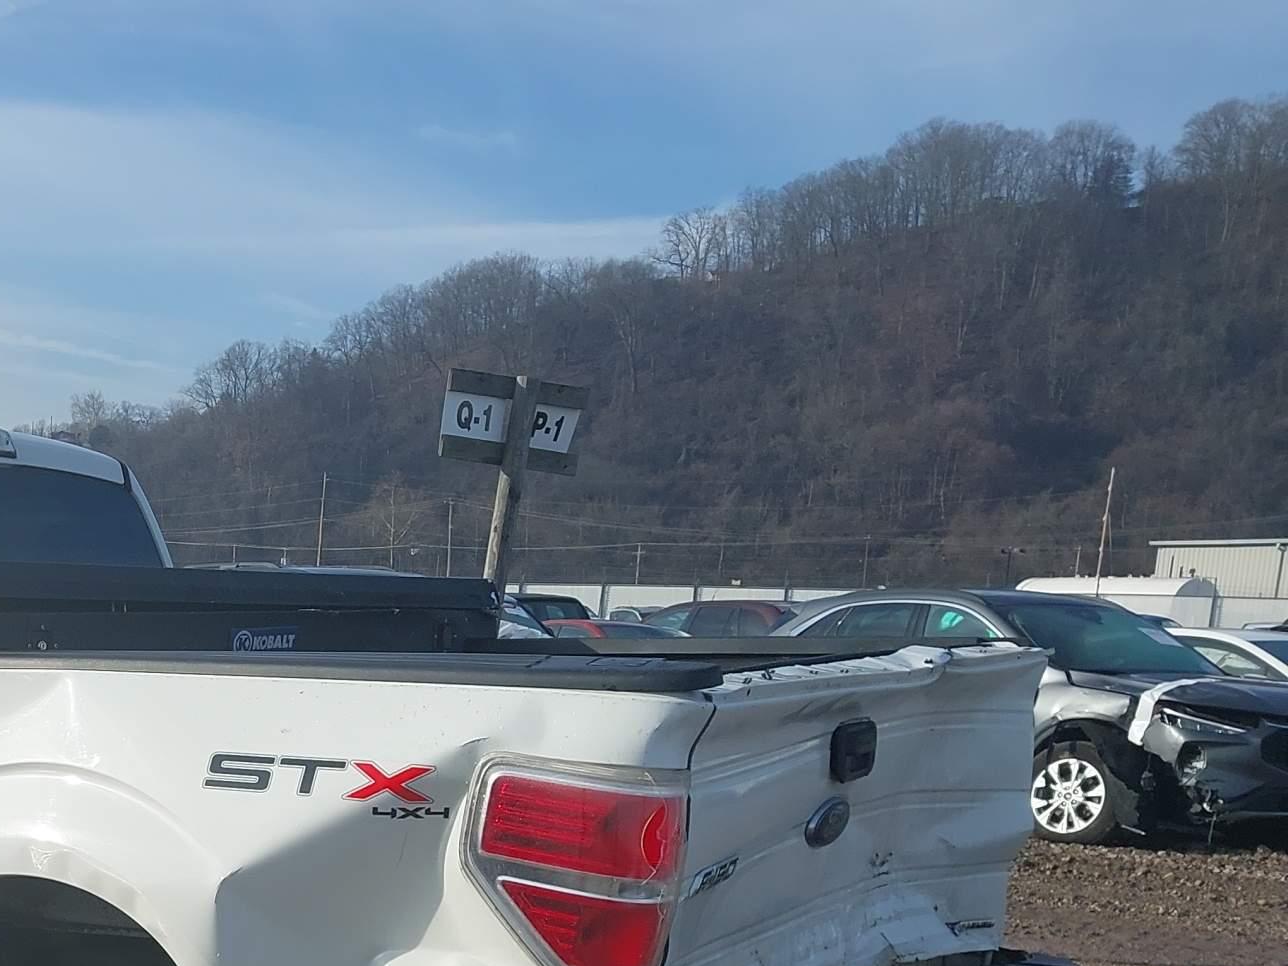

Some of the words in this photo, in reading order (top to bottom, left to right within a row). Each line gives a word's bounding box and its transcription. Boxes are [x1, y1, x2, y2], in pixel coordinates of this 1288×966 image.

[456, 400, 493, 433] Q-1
[531, 411, 565, 442] P-1
[252, 634, 296, 651] KOBALT
[202, 751, 437, 804] STX
